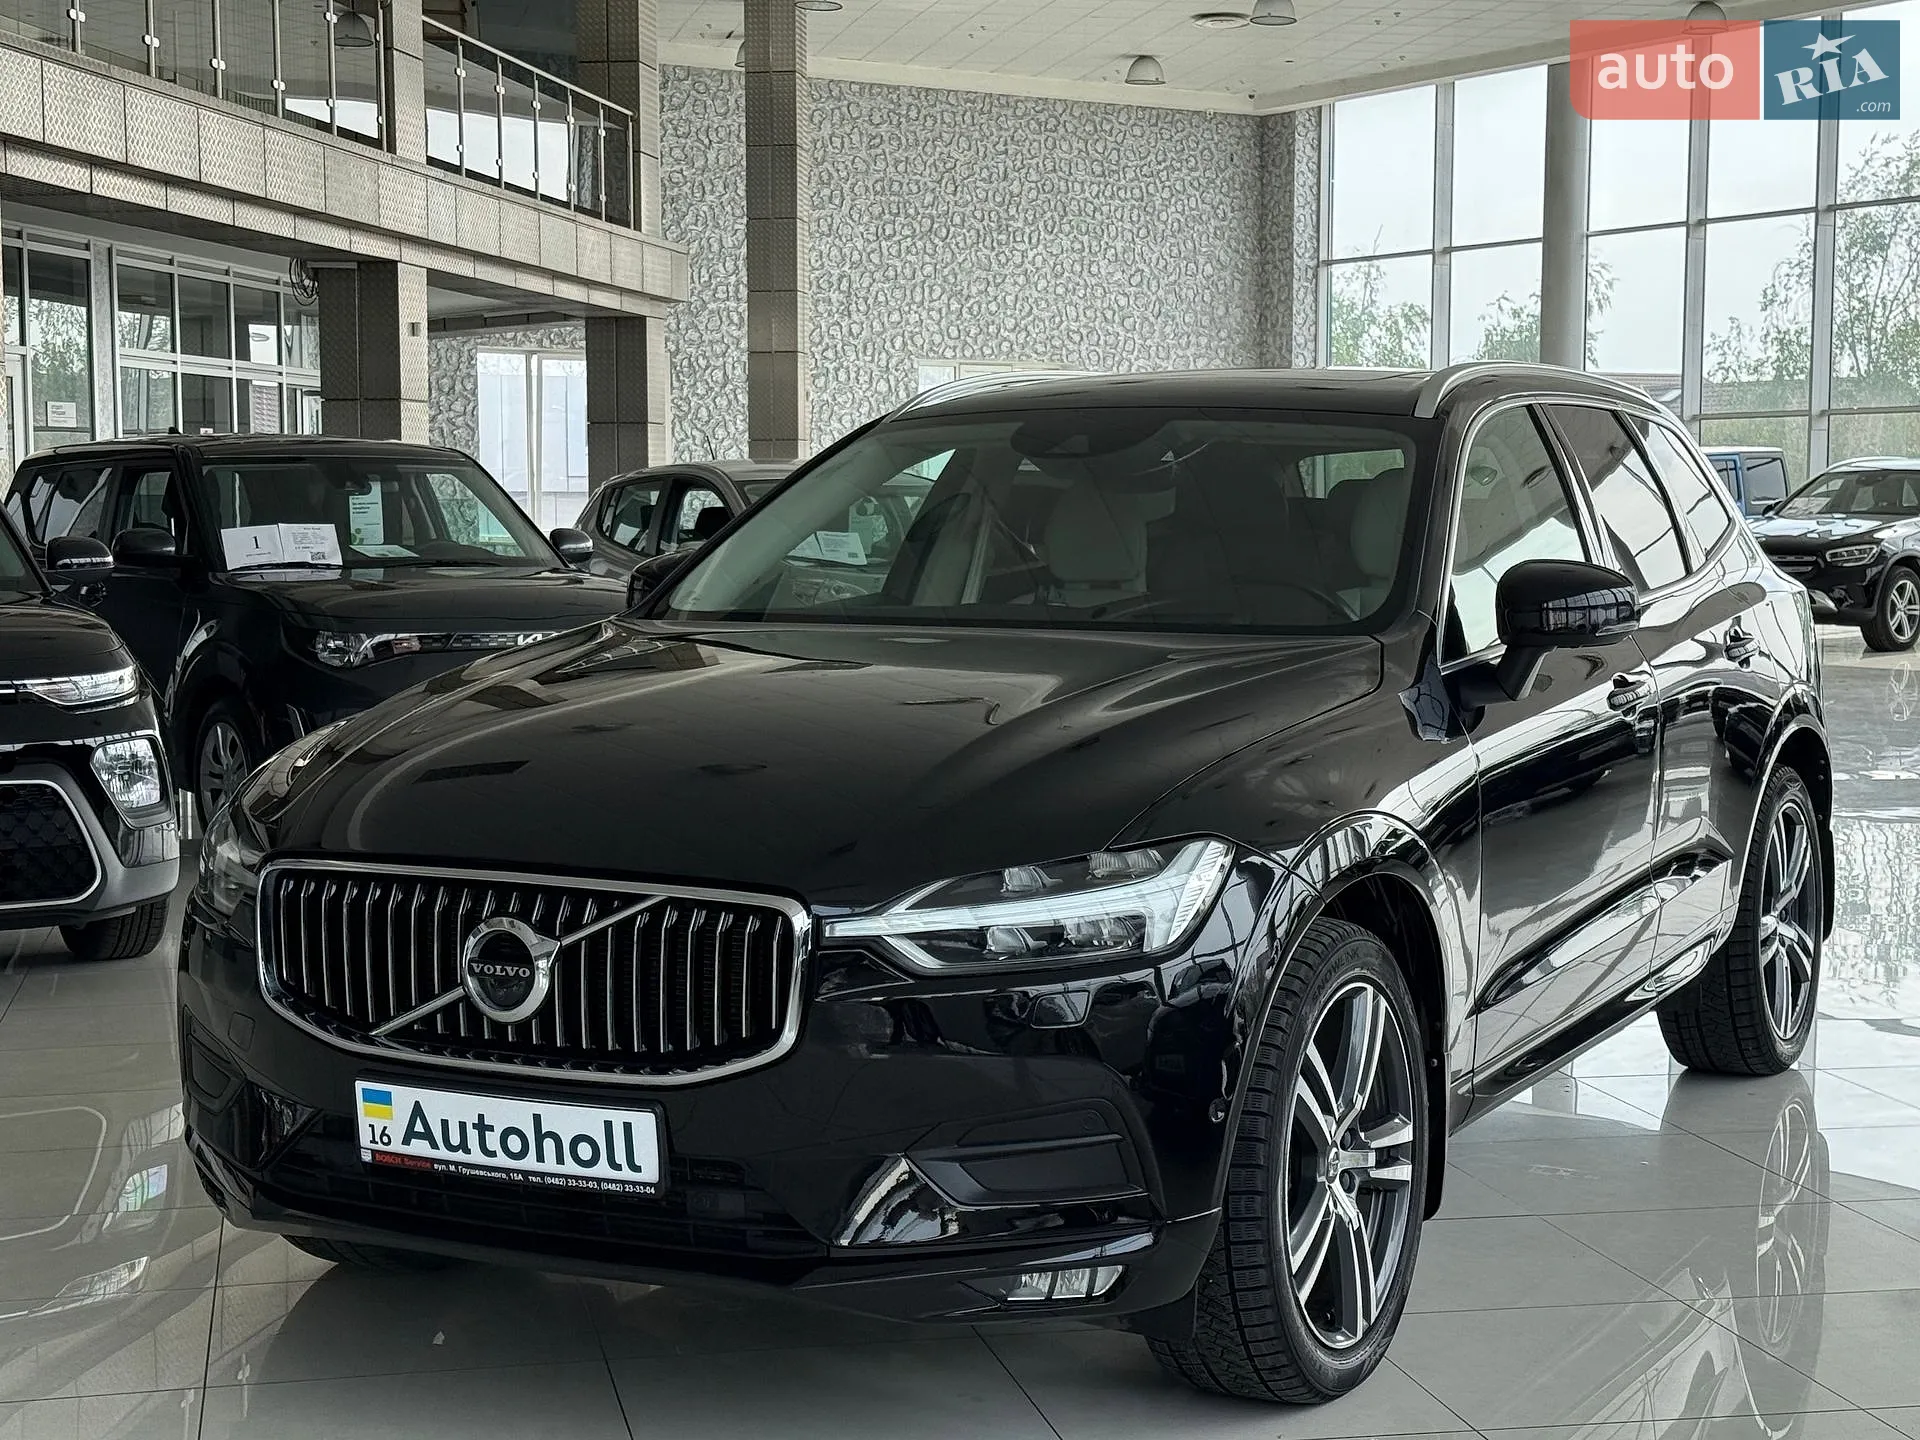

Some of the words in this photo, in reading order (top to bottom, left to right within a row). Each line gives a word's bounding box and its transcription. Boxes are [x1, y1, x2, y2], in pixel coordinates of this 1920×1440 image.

[252, 536, 261, 549] 1
[470, 962, 531, 978] VOLVO
[368, 1123, 392, 1147] 16
[401, 1100, 642, 1174] Autoholl
[624, 1184, 656, 1194] 33-33-04
